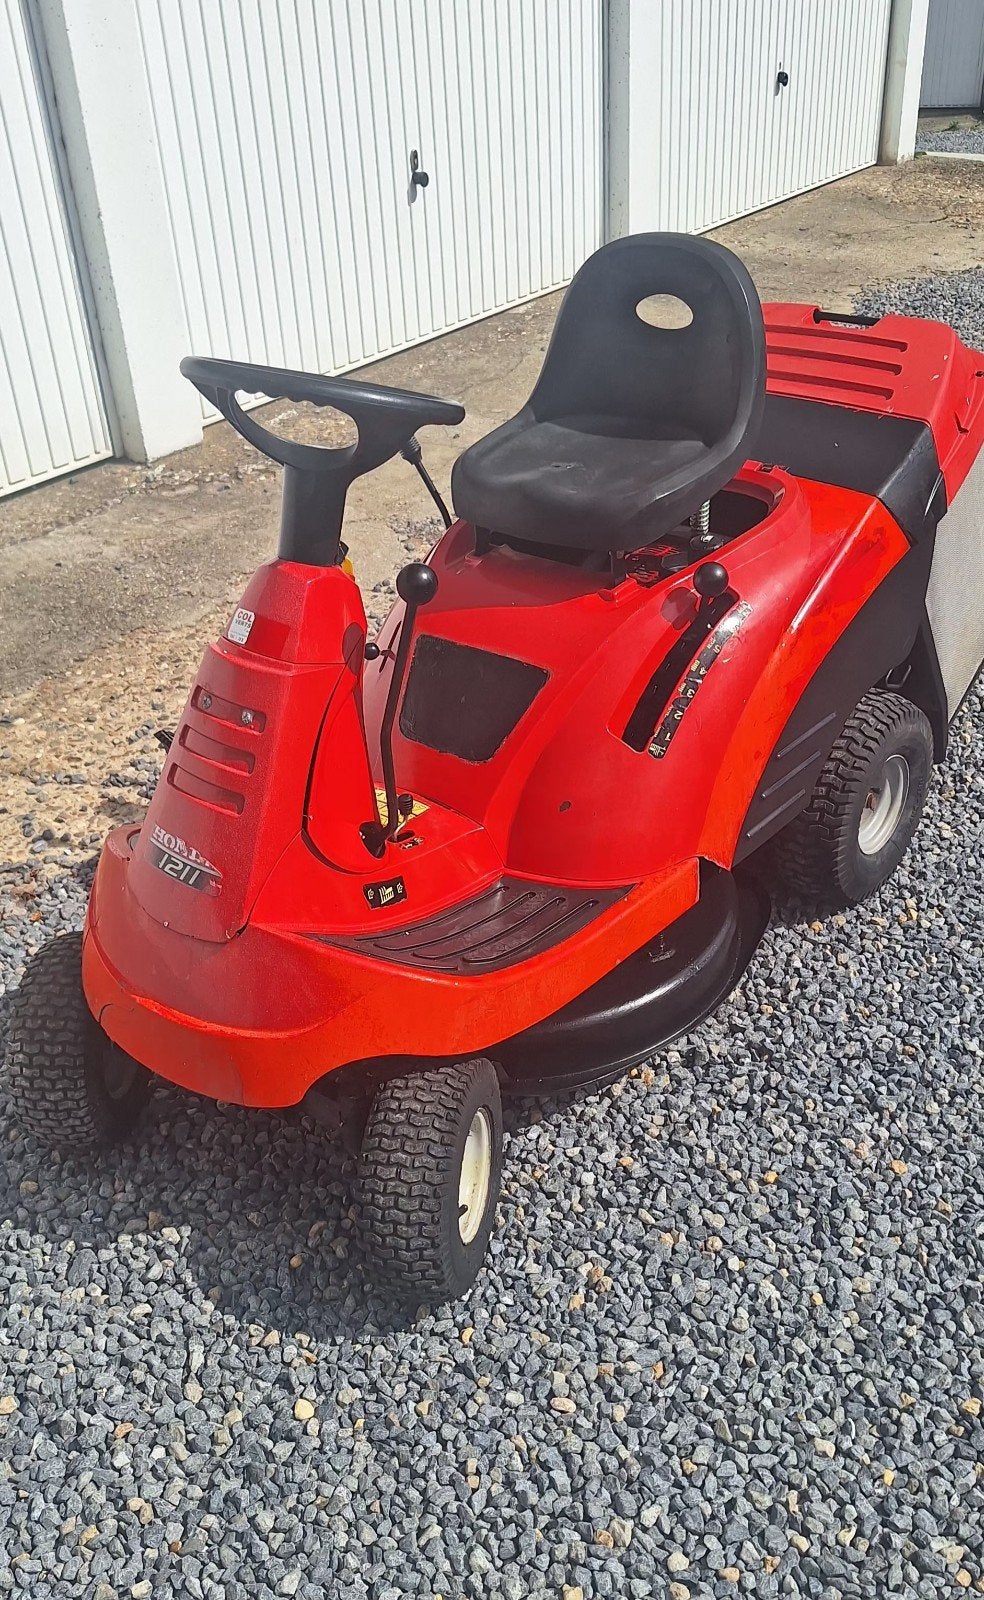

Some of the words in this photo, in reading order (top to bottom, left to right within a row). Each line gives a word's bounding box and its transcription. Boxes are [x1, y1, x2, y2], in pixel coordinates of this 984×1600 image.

[237, 611, 252, 622] COL
[686, 688, 695, 698] 3
[674, 710, 684, 720] 2
[664, 732, 671, 742] 1
[157, 853, 201, 885] 1211
